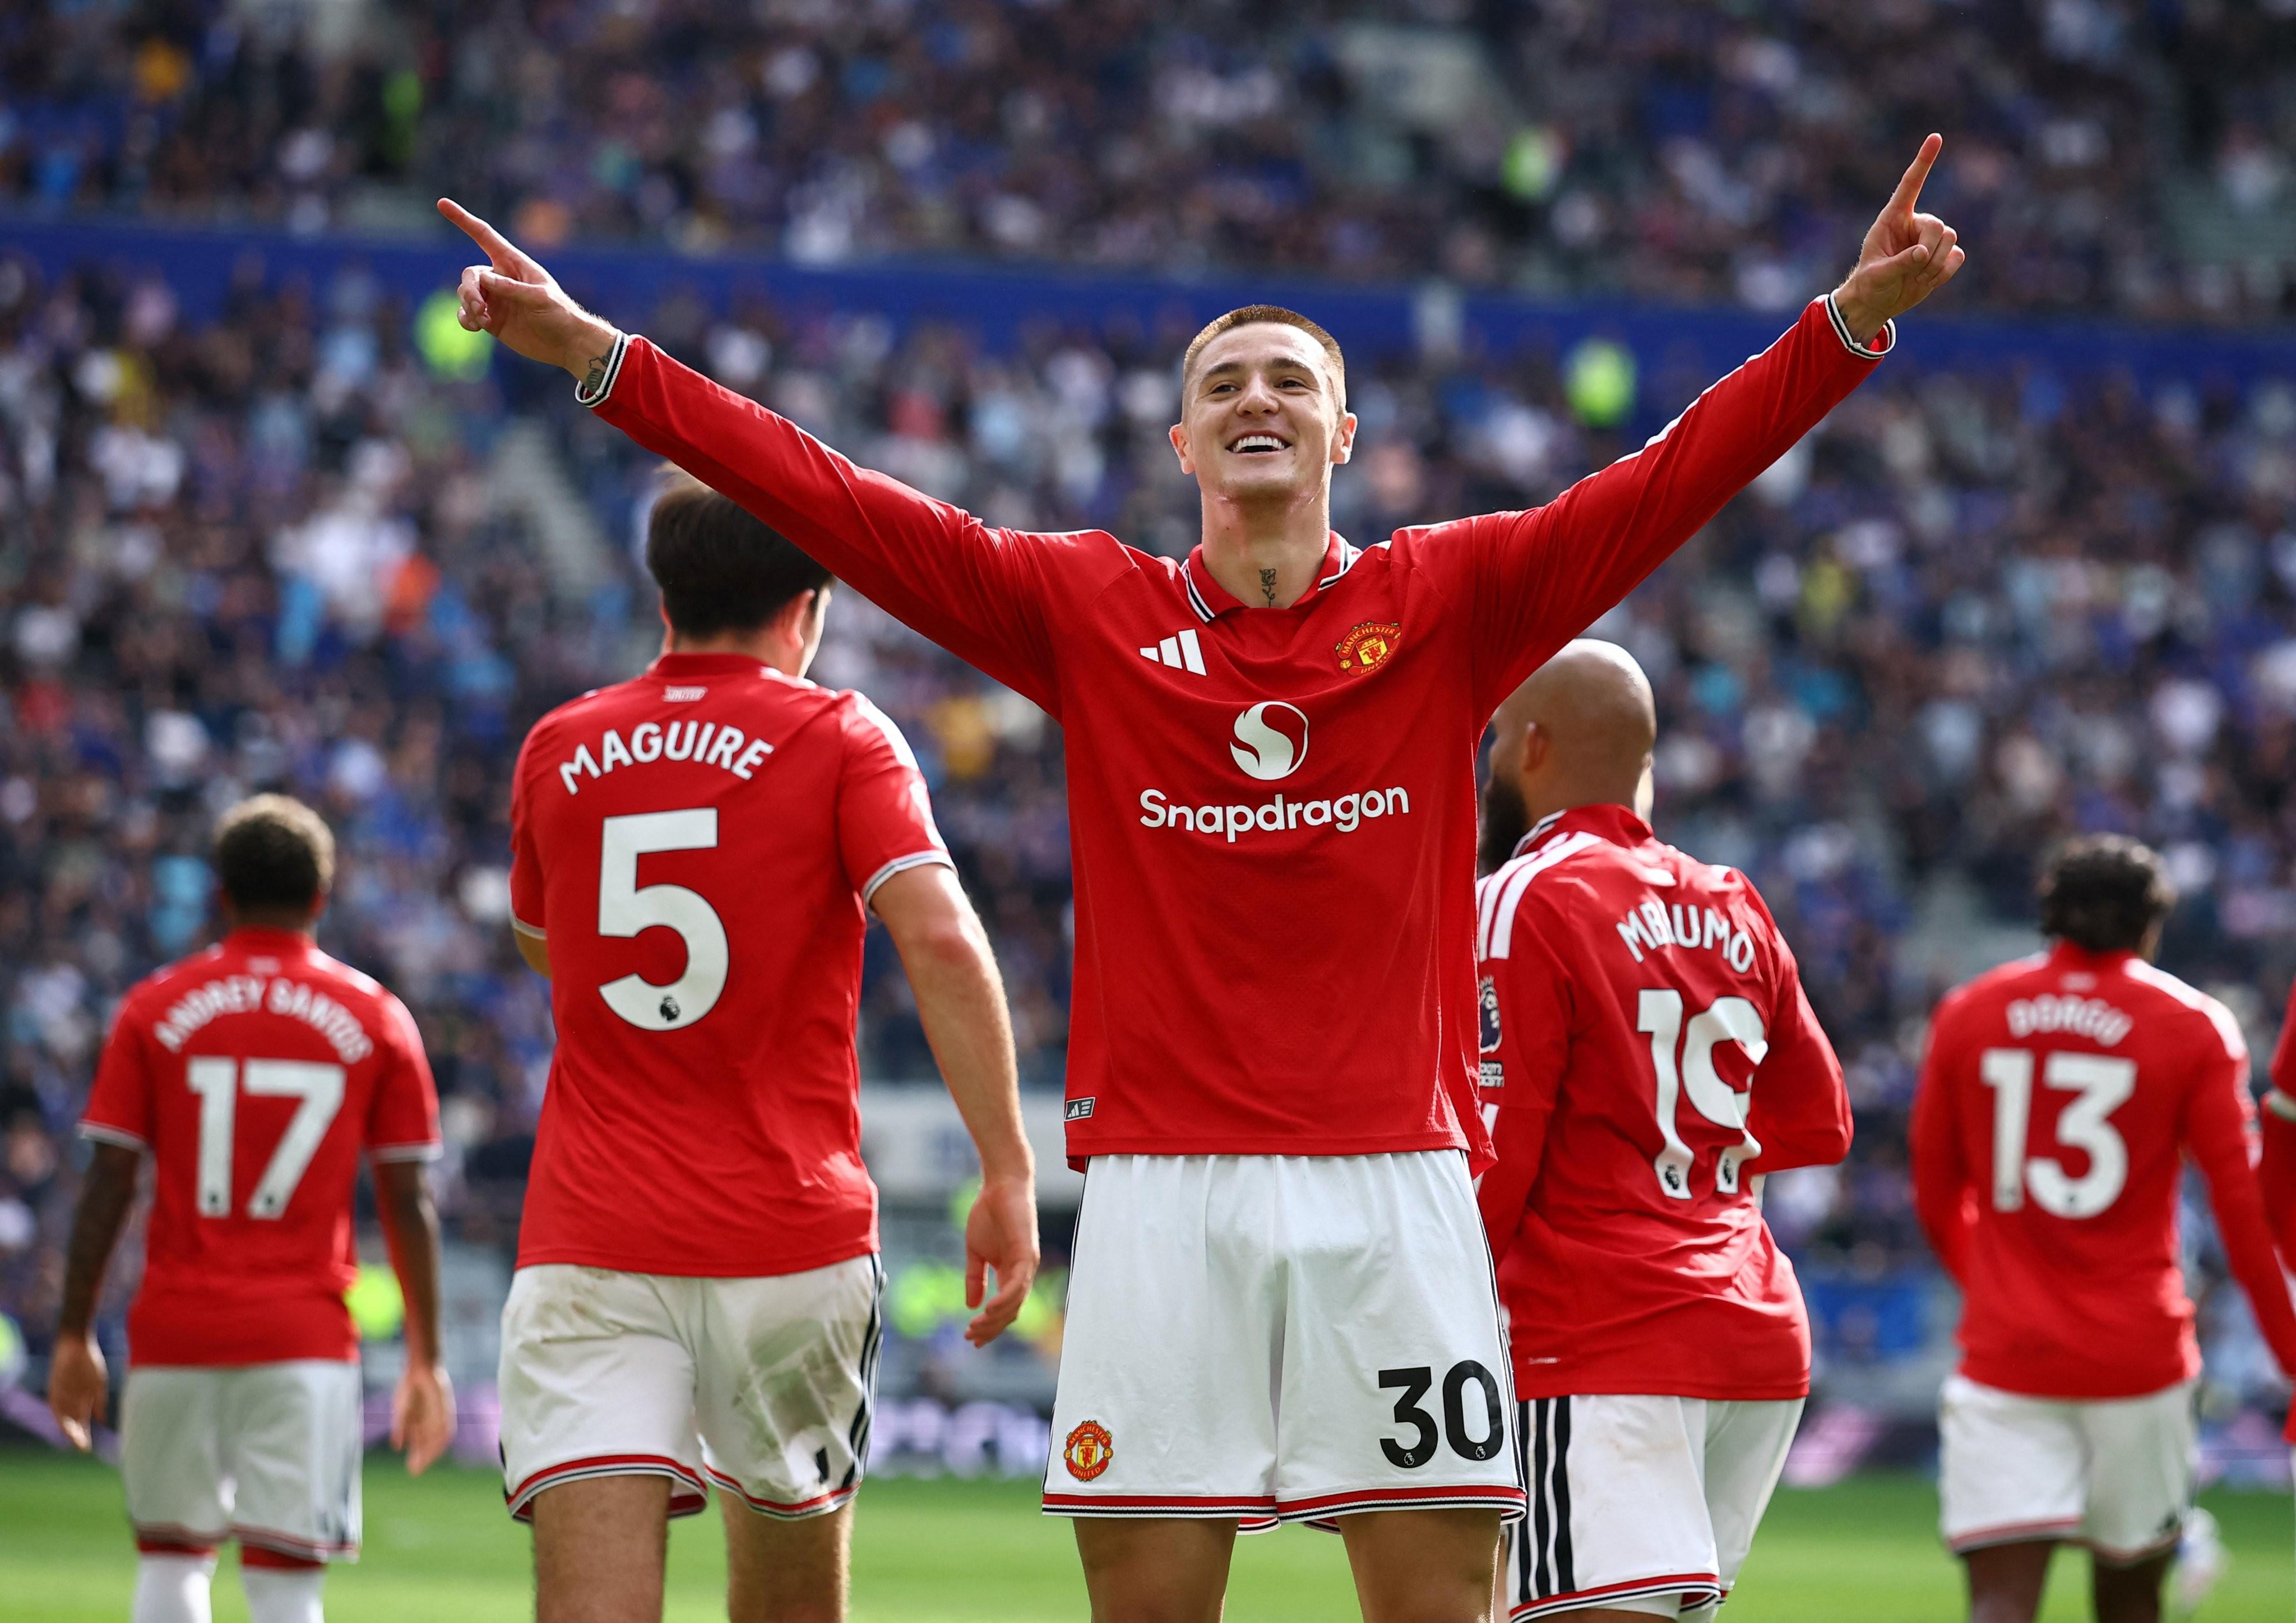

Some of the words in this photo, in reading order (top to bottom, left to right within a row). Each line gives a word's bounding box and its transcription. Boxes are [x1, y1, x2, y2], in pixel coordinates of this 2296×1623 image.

[1341, 626, 1396, 655] MANCHESTER
[560, 720, 774, 796] MAGUIRE
[1140, 786, 1410, 843] Snapdragon
[598, 807, 729, 1032] 5
[1616, 901, 1755, 974] MBUMO
[187, 1055, 346, 1219] 17
[1980, 1047, 2138, 1219] 13
[1070, 1425, 1108, 1445] MANCHESTER
[1378, 1360, 1504, 1469] 30
[1073, 1467, 1100, 1477] UNITED
